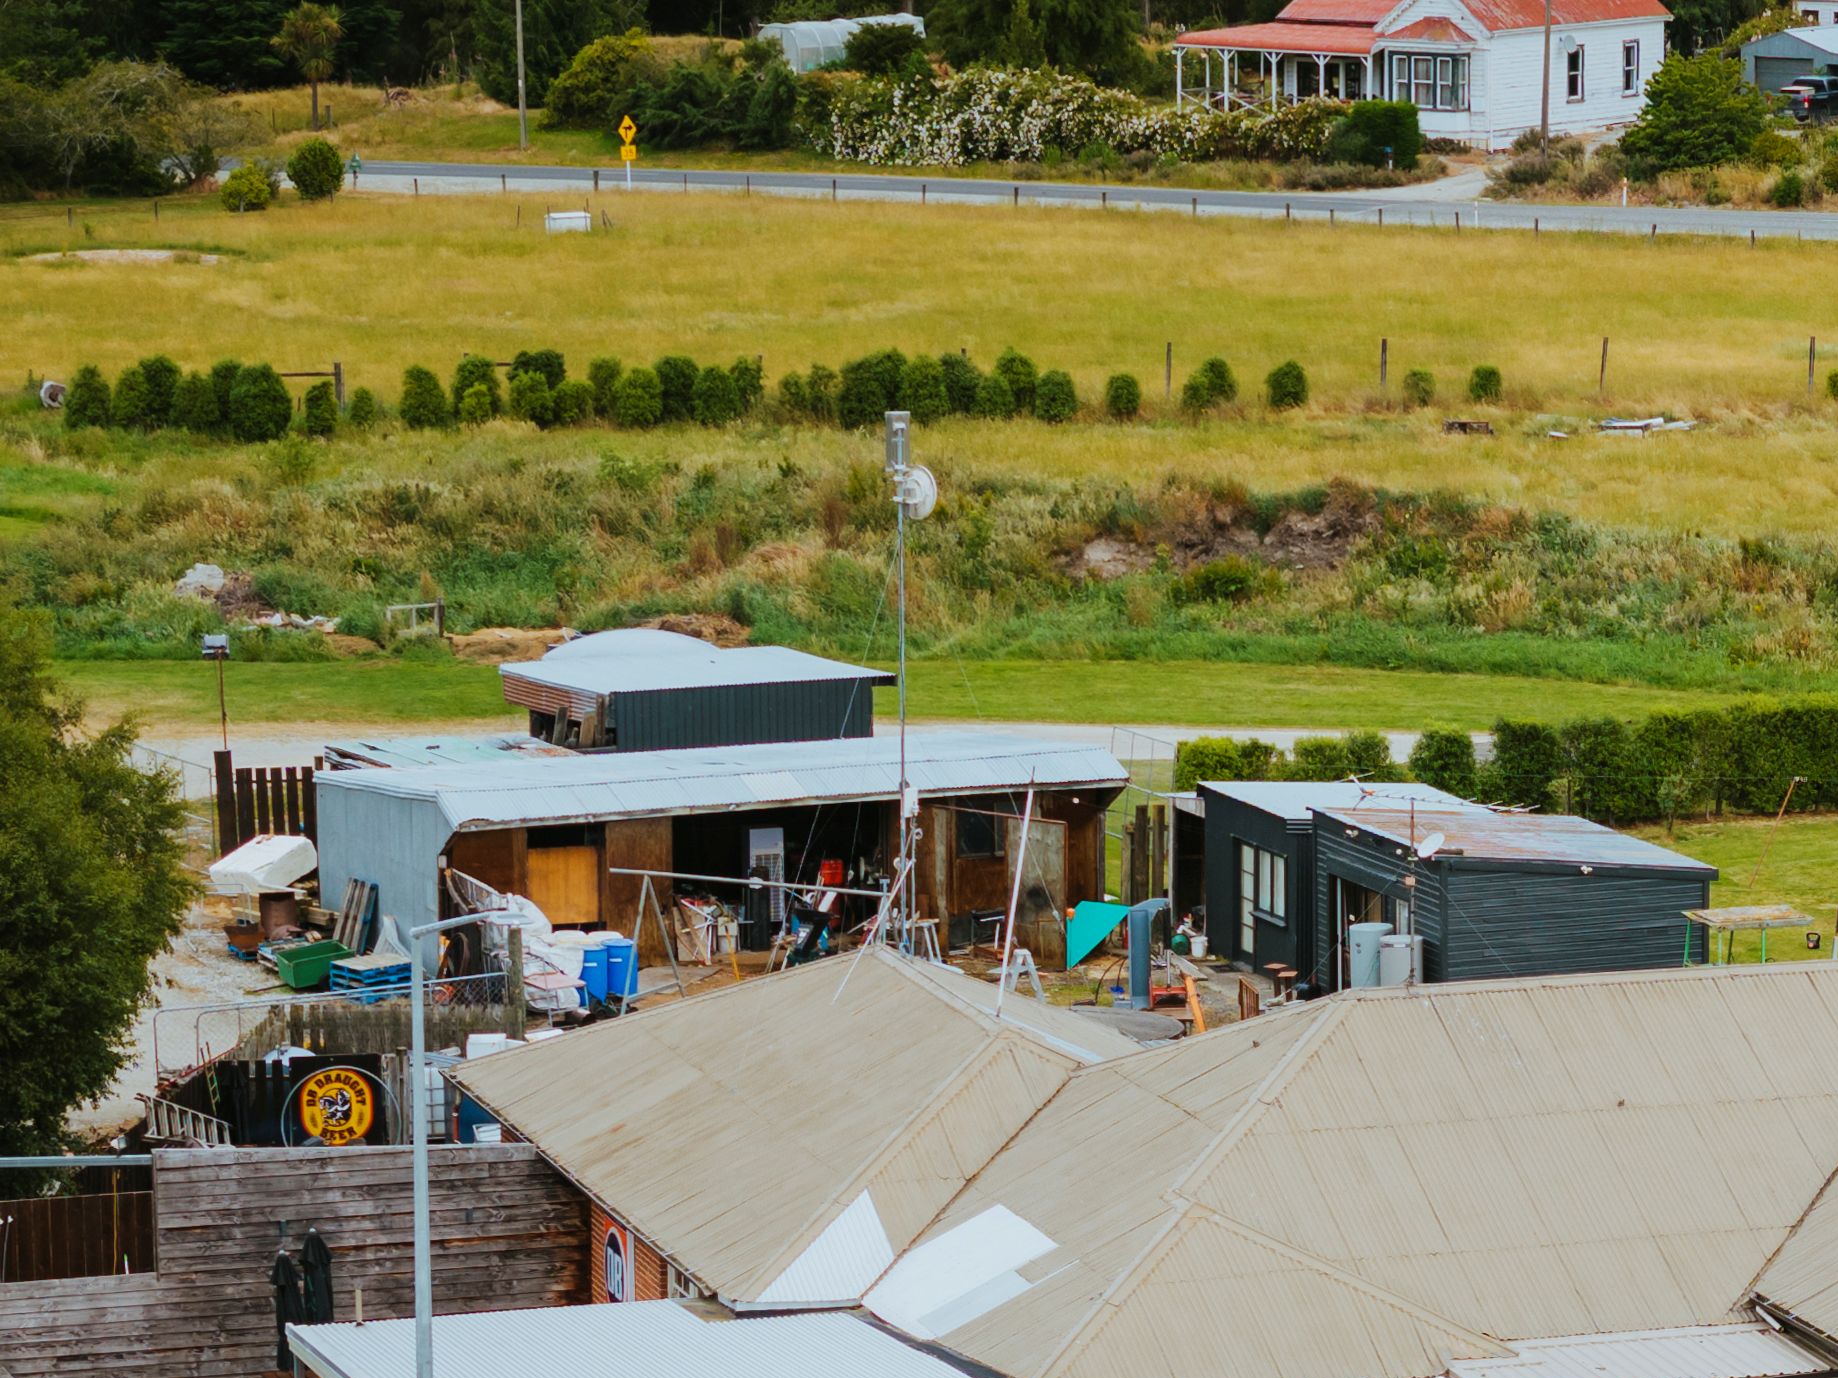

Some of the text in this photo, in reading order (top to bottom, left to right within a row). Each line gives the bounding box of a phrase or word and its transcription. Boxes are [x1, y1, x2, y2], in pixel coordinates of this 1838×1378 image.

[306, 1073, 367, 1107] DB DRAUGHT
[320, 1127, 357, 1140] BEER
[607, 1246, 622, 1301] DB
